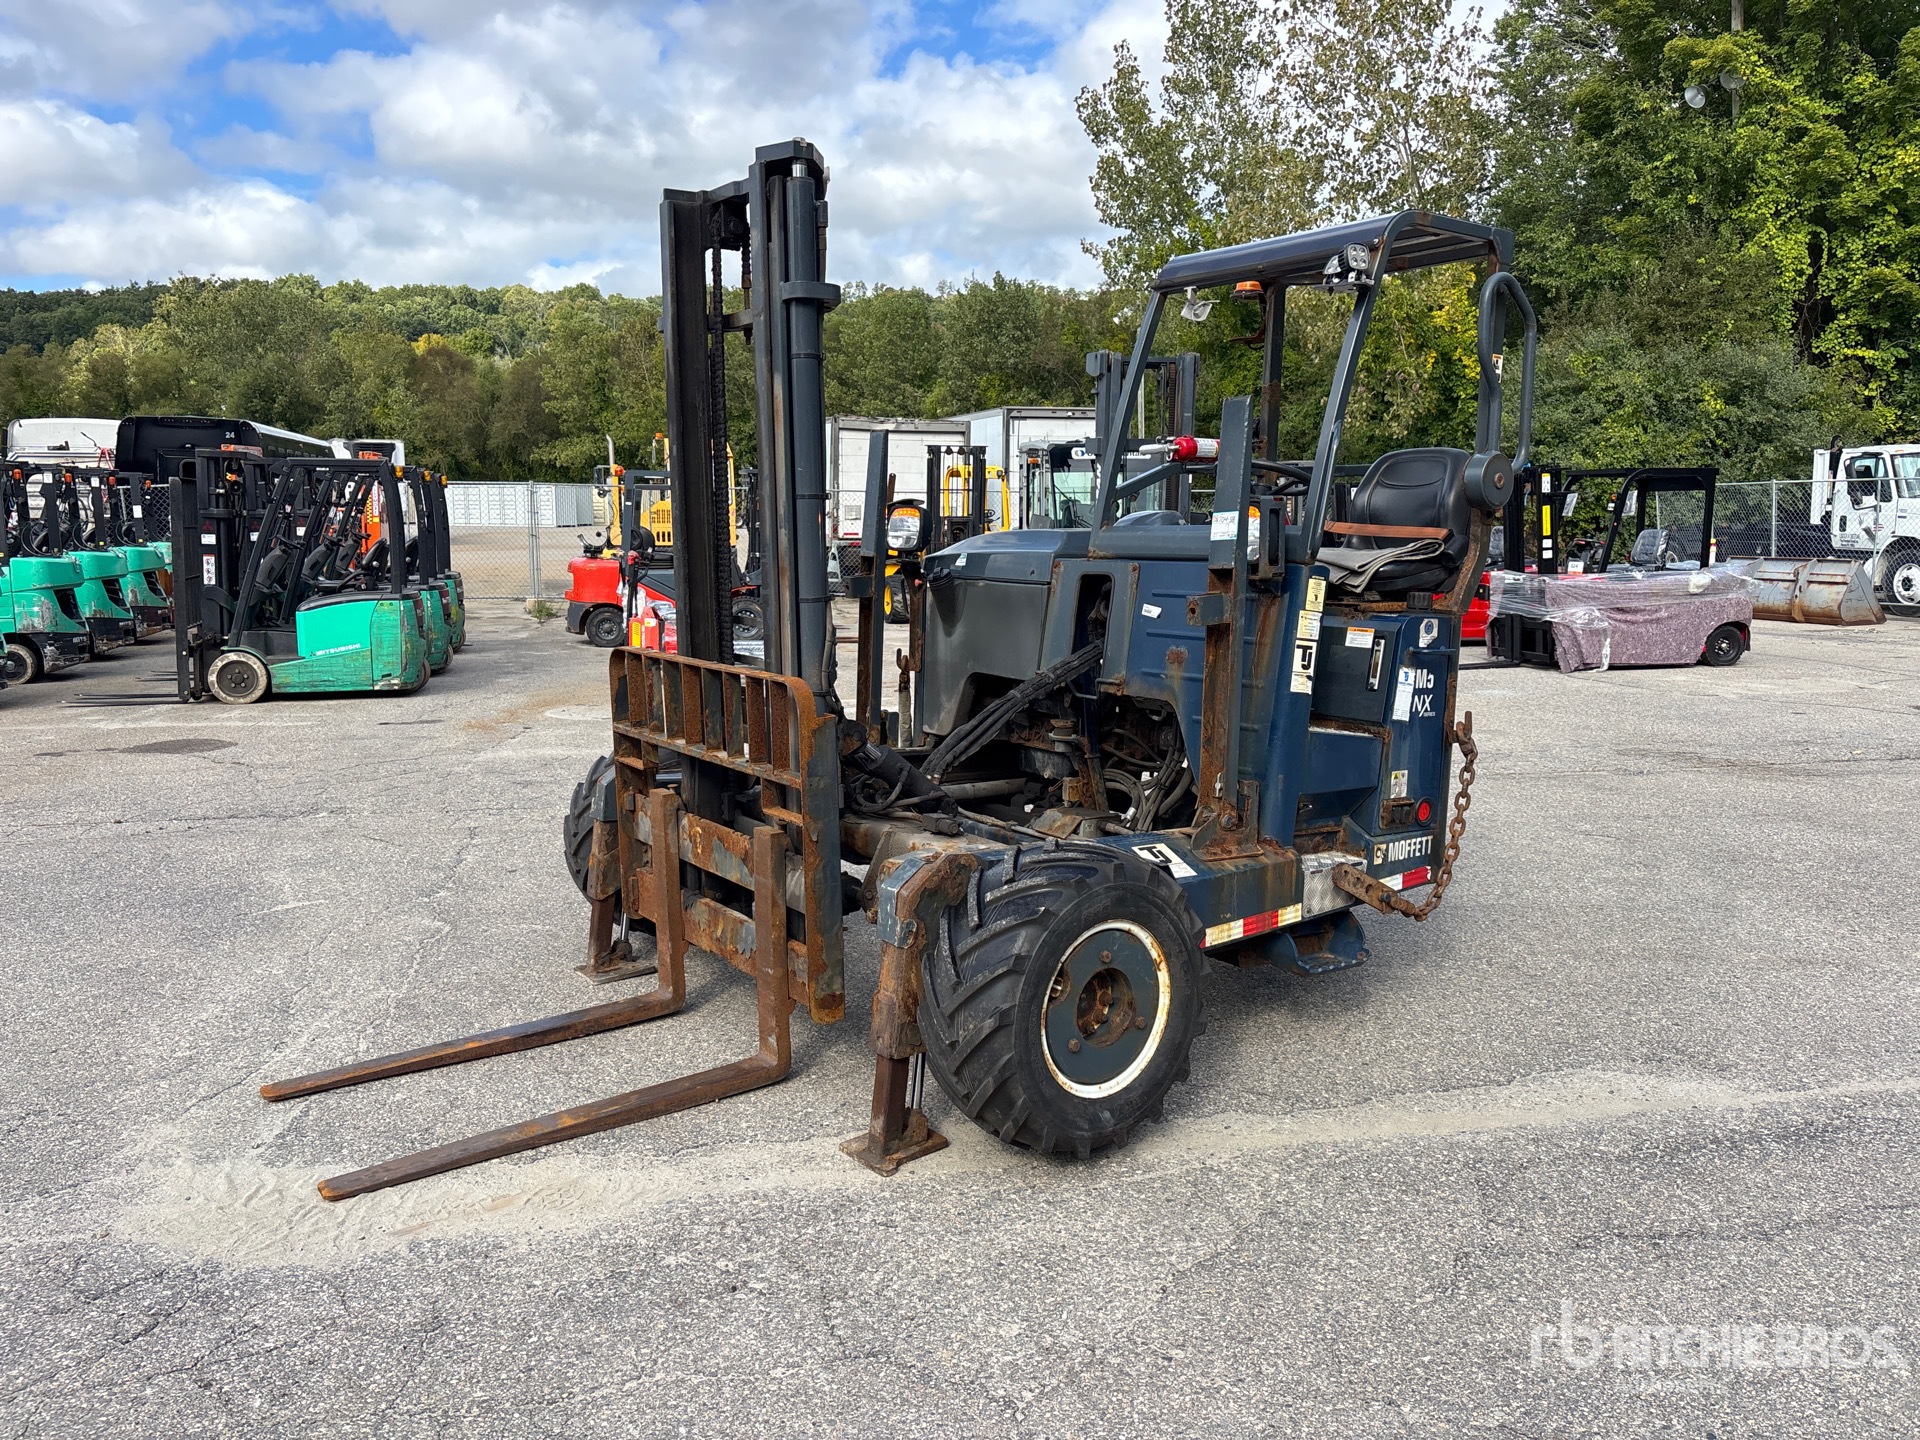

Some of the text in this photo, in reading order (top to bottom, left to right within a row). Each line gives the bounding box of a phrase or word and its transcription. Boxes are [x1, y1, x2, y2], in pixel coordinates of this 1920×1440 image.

[225, 431, 236, 439] 24
[316, 643, 361, 656] MITSUBISHI
[1412, 694, 1433, 717] NX
[1388, 835, 1434, 862] MOFFETT
